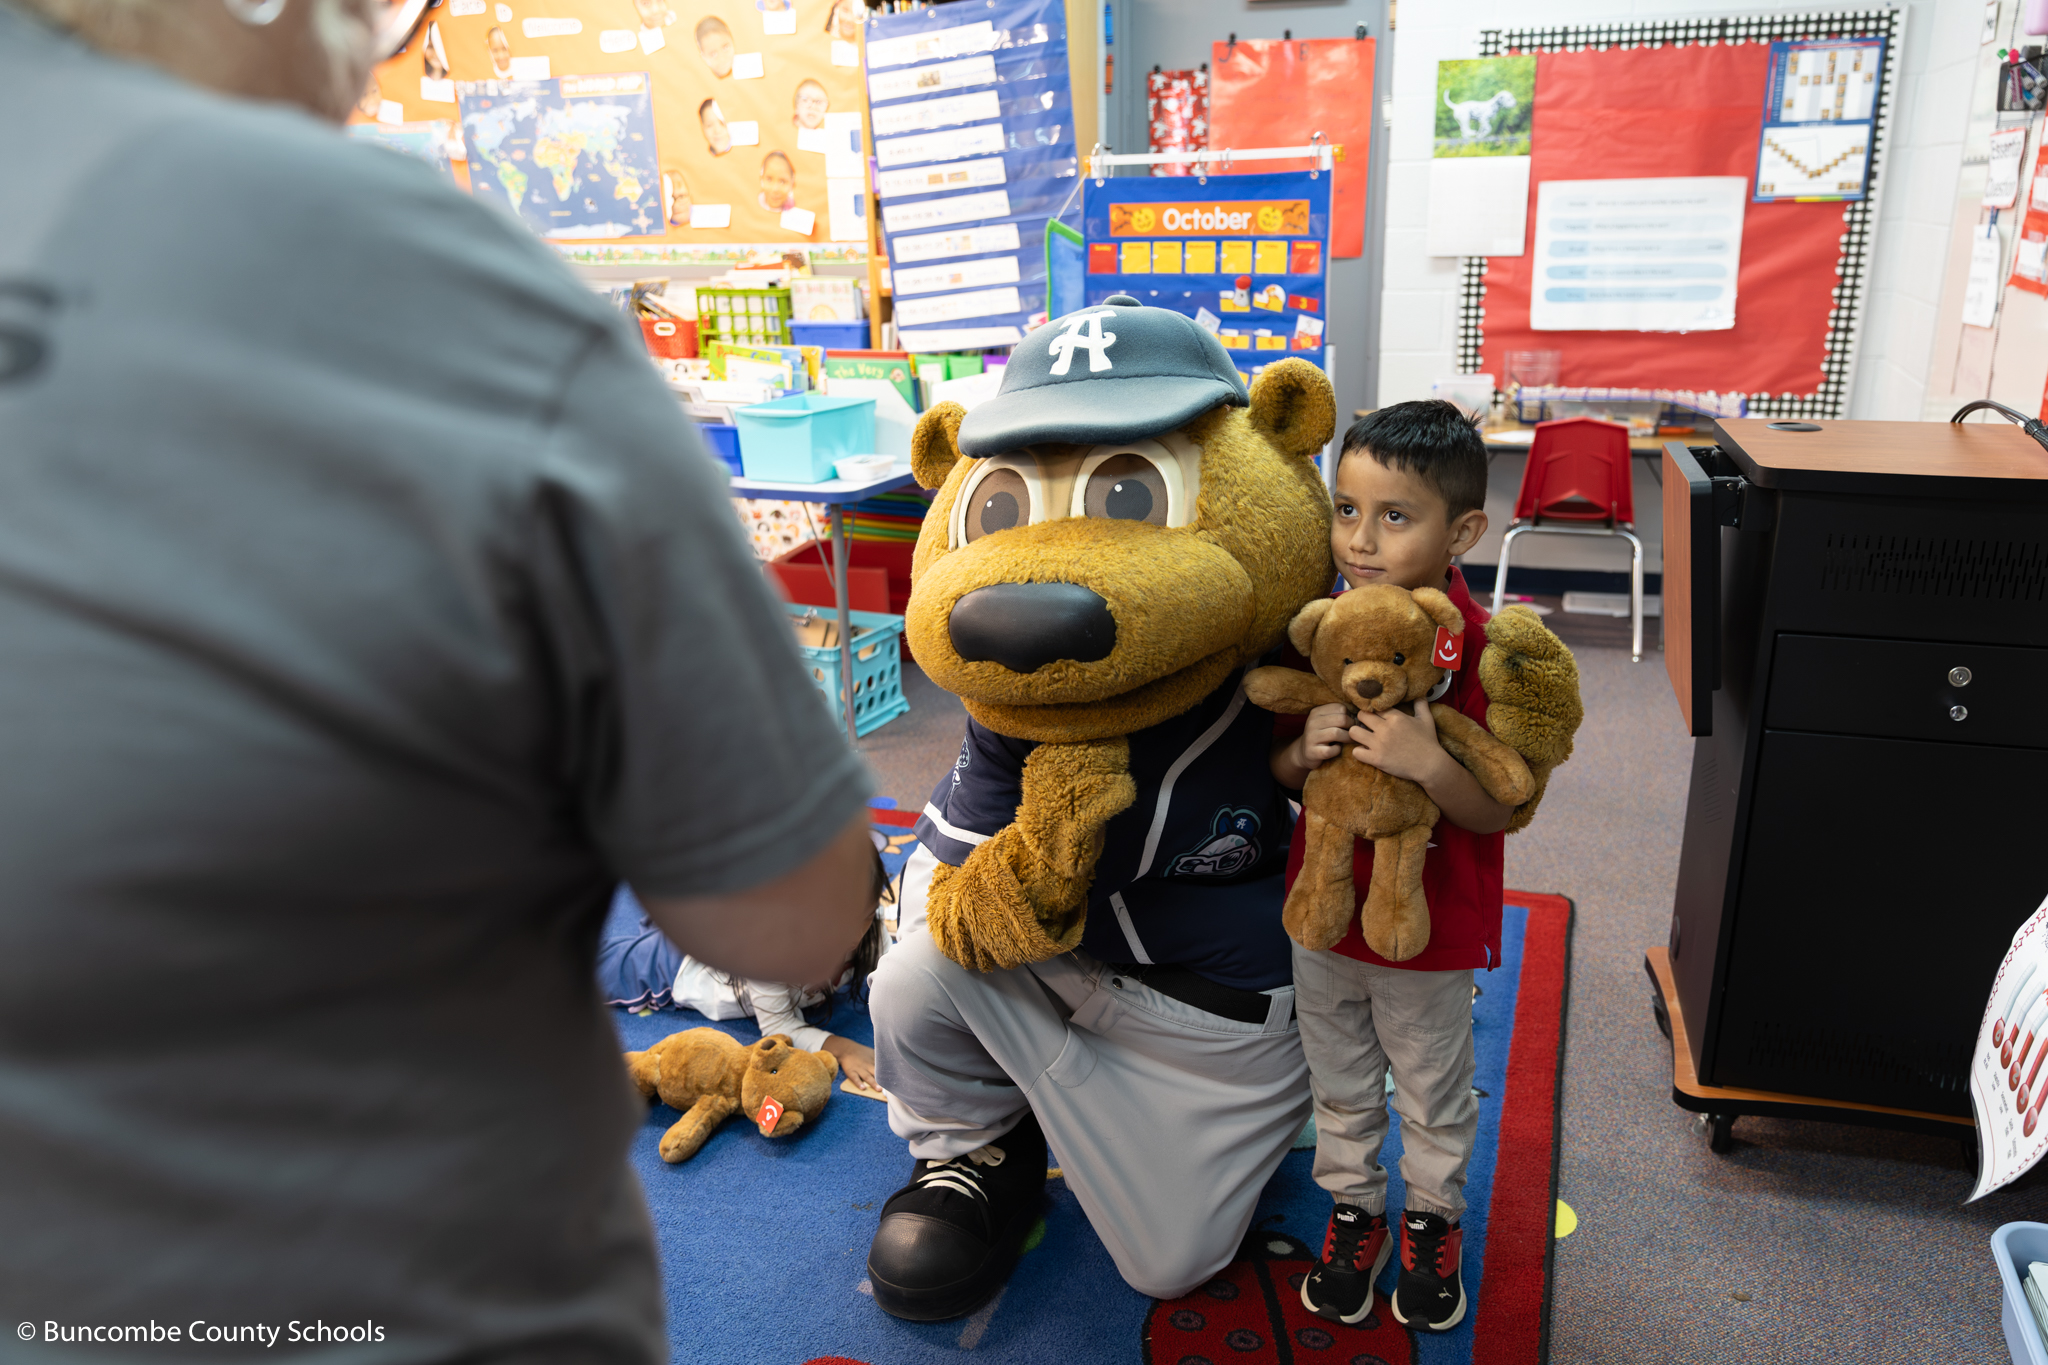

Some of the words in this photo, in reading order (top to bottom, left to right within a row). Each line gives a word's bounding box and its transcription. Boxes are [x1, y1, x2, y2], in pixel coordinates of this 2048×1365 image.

[1162, 206, 1253, 231] October
[1299, 297, 1308, 310] 3
[1048, 309, 1117, 375] A
[857, 363, 884, 379] Very
[1337, 1213, 1354, 1222] PUMA
